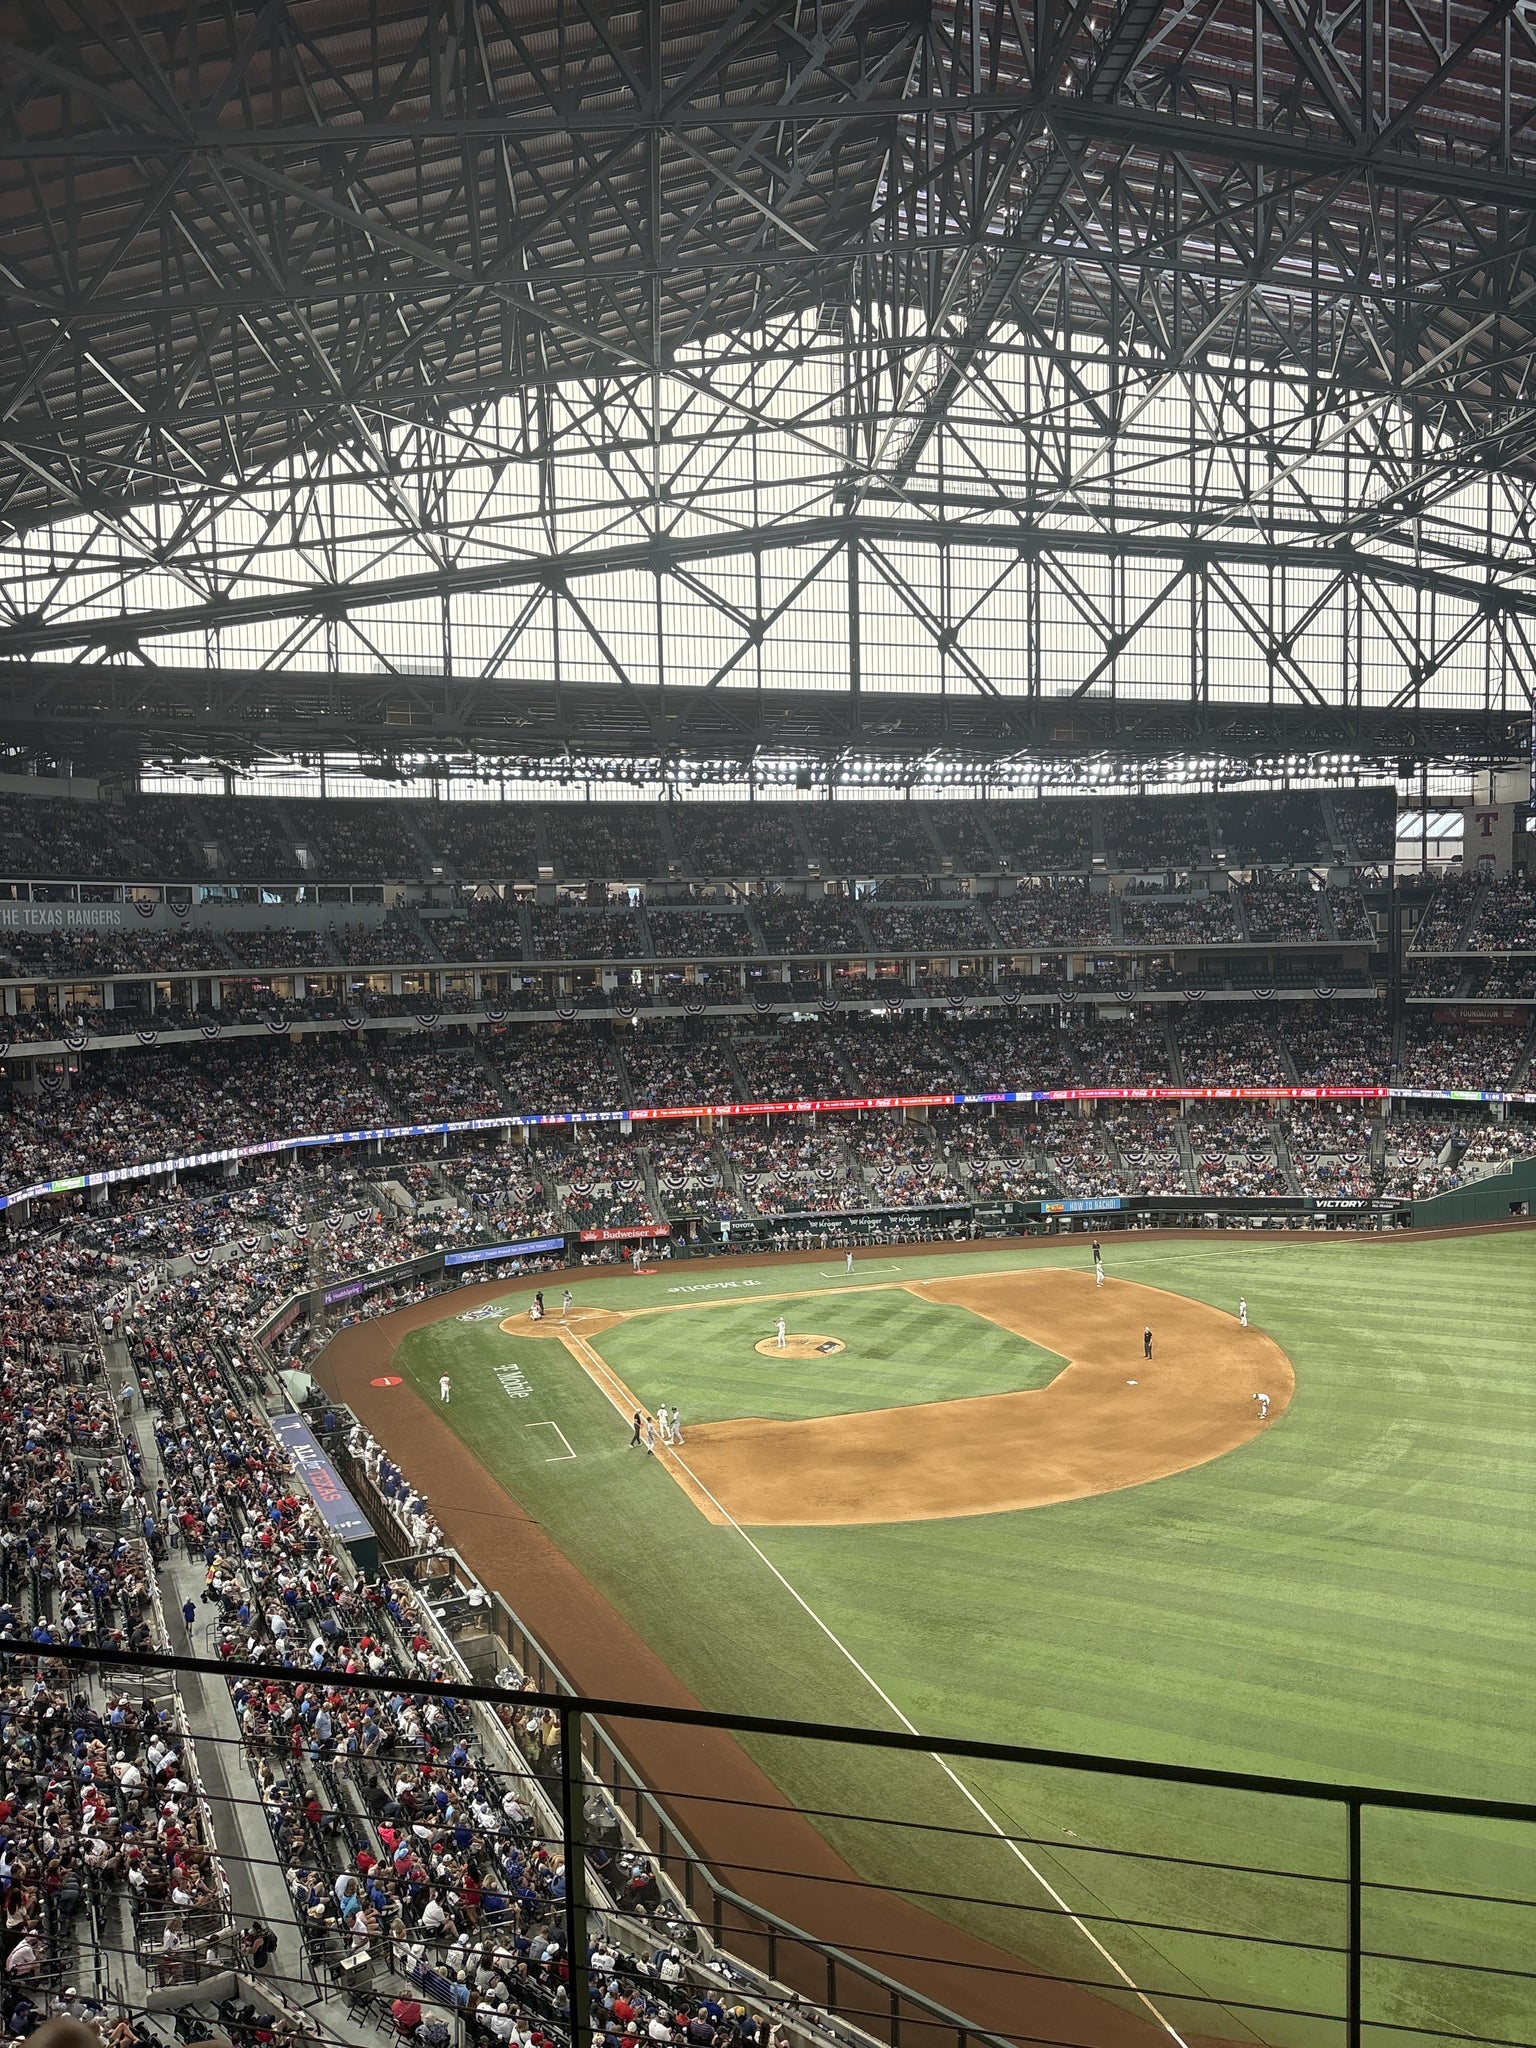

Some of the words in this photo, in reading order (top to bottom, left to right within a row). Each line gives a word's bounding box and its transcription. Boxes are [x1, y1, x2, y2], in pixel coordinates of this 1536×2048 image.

[23, 910, 62, 925] TEXAS
[67, 910, 121, 925] RANGERS
[1460, 1008, 1498, 1018] FOUNDATION
[1069, 1202, 1083, 1212] HOW
[1086, 1202, 1093, 1211] TO
[1316, 1200, 1363, 1208] VICTORY
[819, 1219, 843, 1231] Kroger
[859, 1216, 883, 1228] Kroger
[899, 1214, 922, 1225] Kroger
[602, 1229, 650, 1239] Budweiser
[333, 1287, 360, 1301] HealthSpring
[308, 1469, 342, 1502] TEXAS
